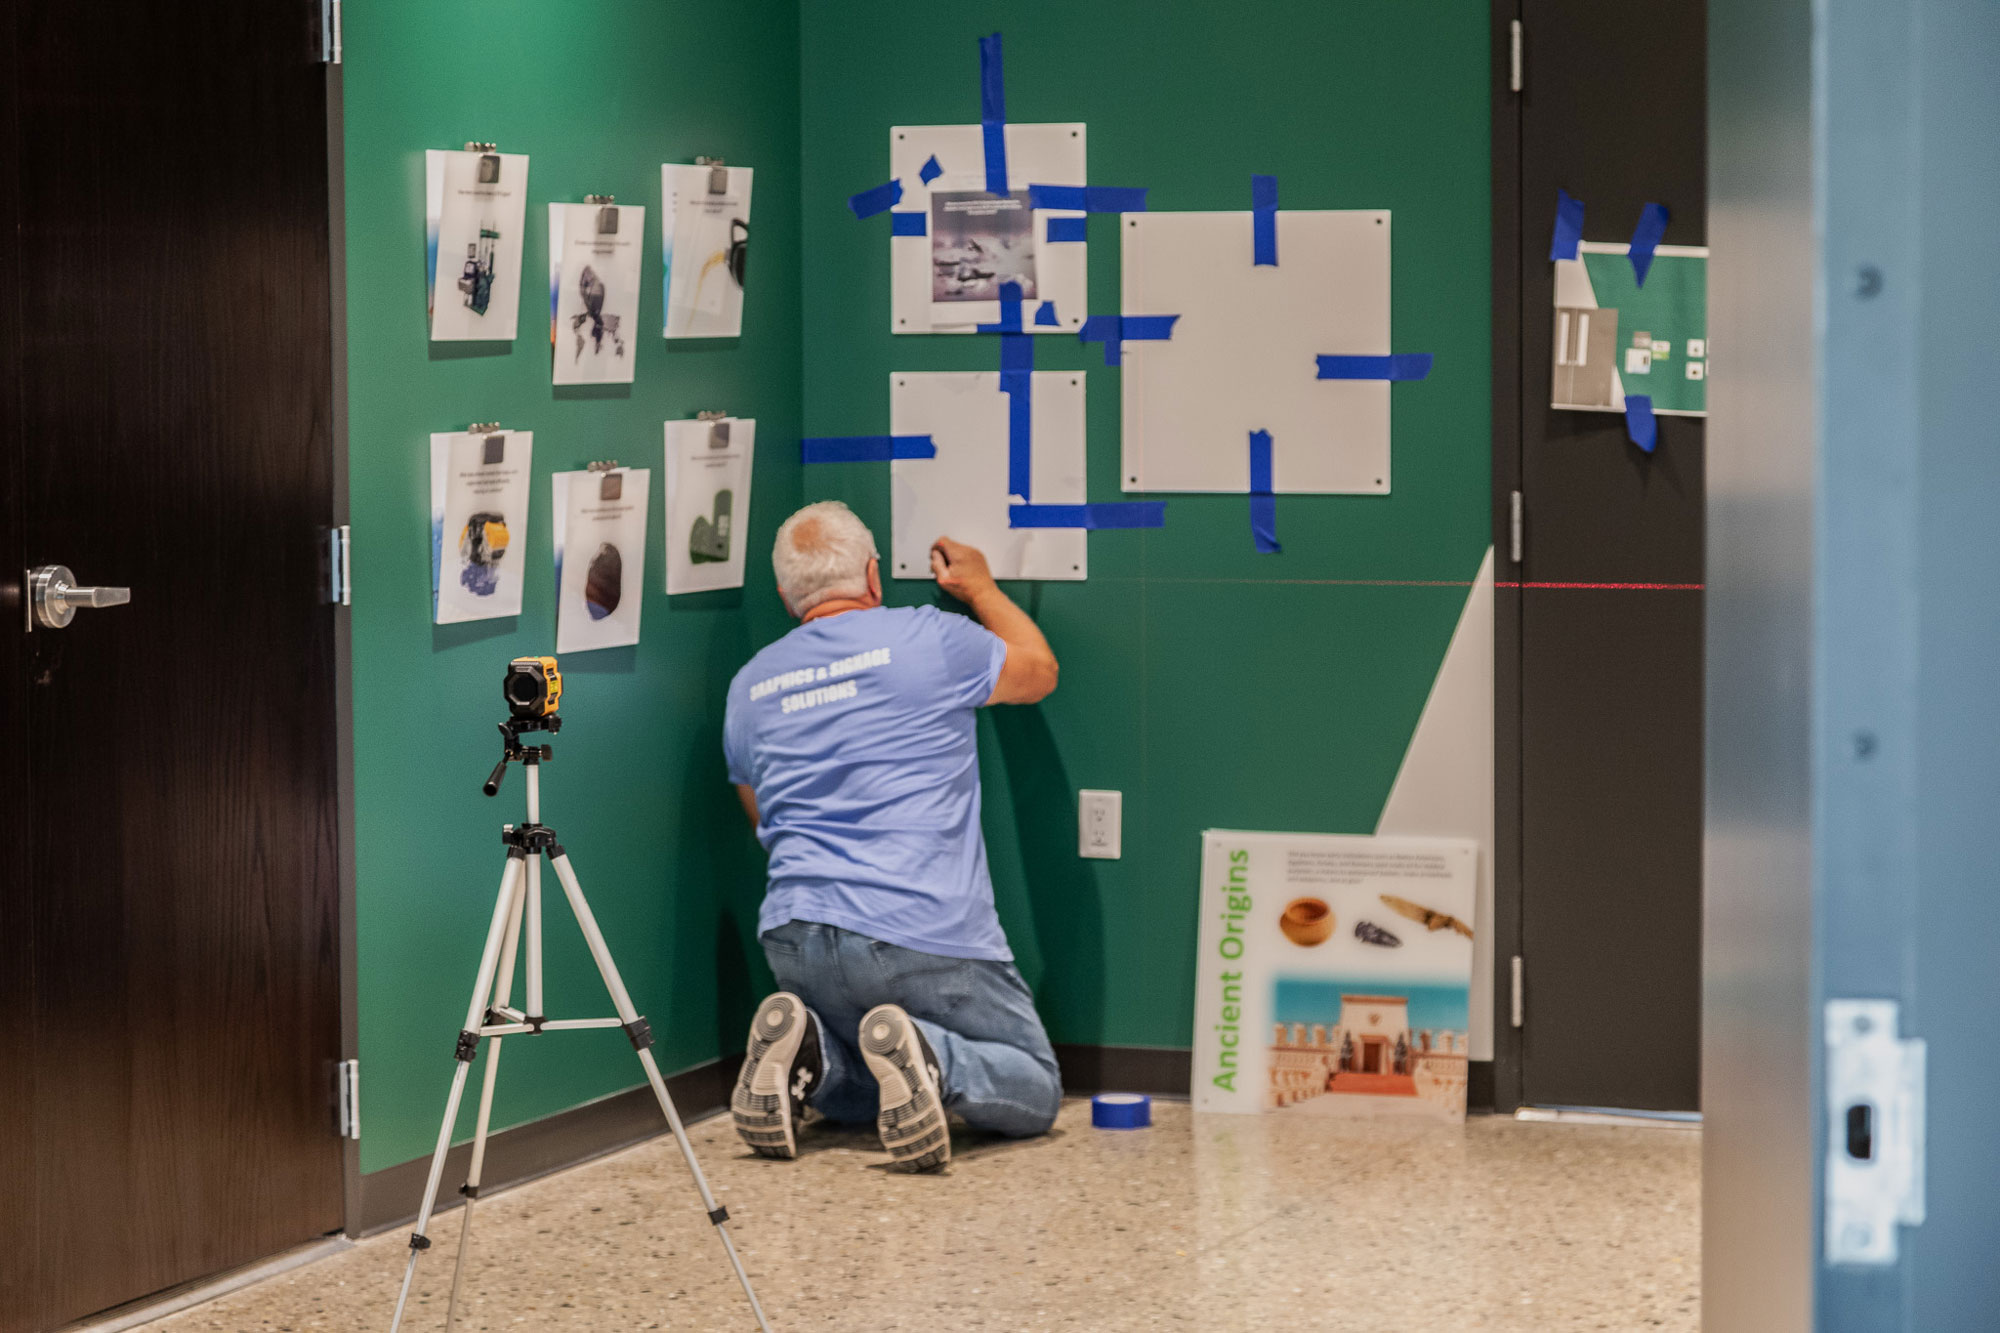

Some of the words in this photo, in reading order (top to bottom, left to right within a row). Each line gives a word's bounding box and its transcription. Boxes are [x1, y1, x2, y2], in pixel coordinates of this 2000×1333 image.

[781, 679, 857, 714] SOLUTIONS
[1219, 849, 1252, 960] Origins
[1213, 971, 1242, 1092] Ancient
